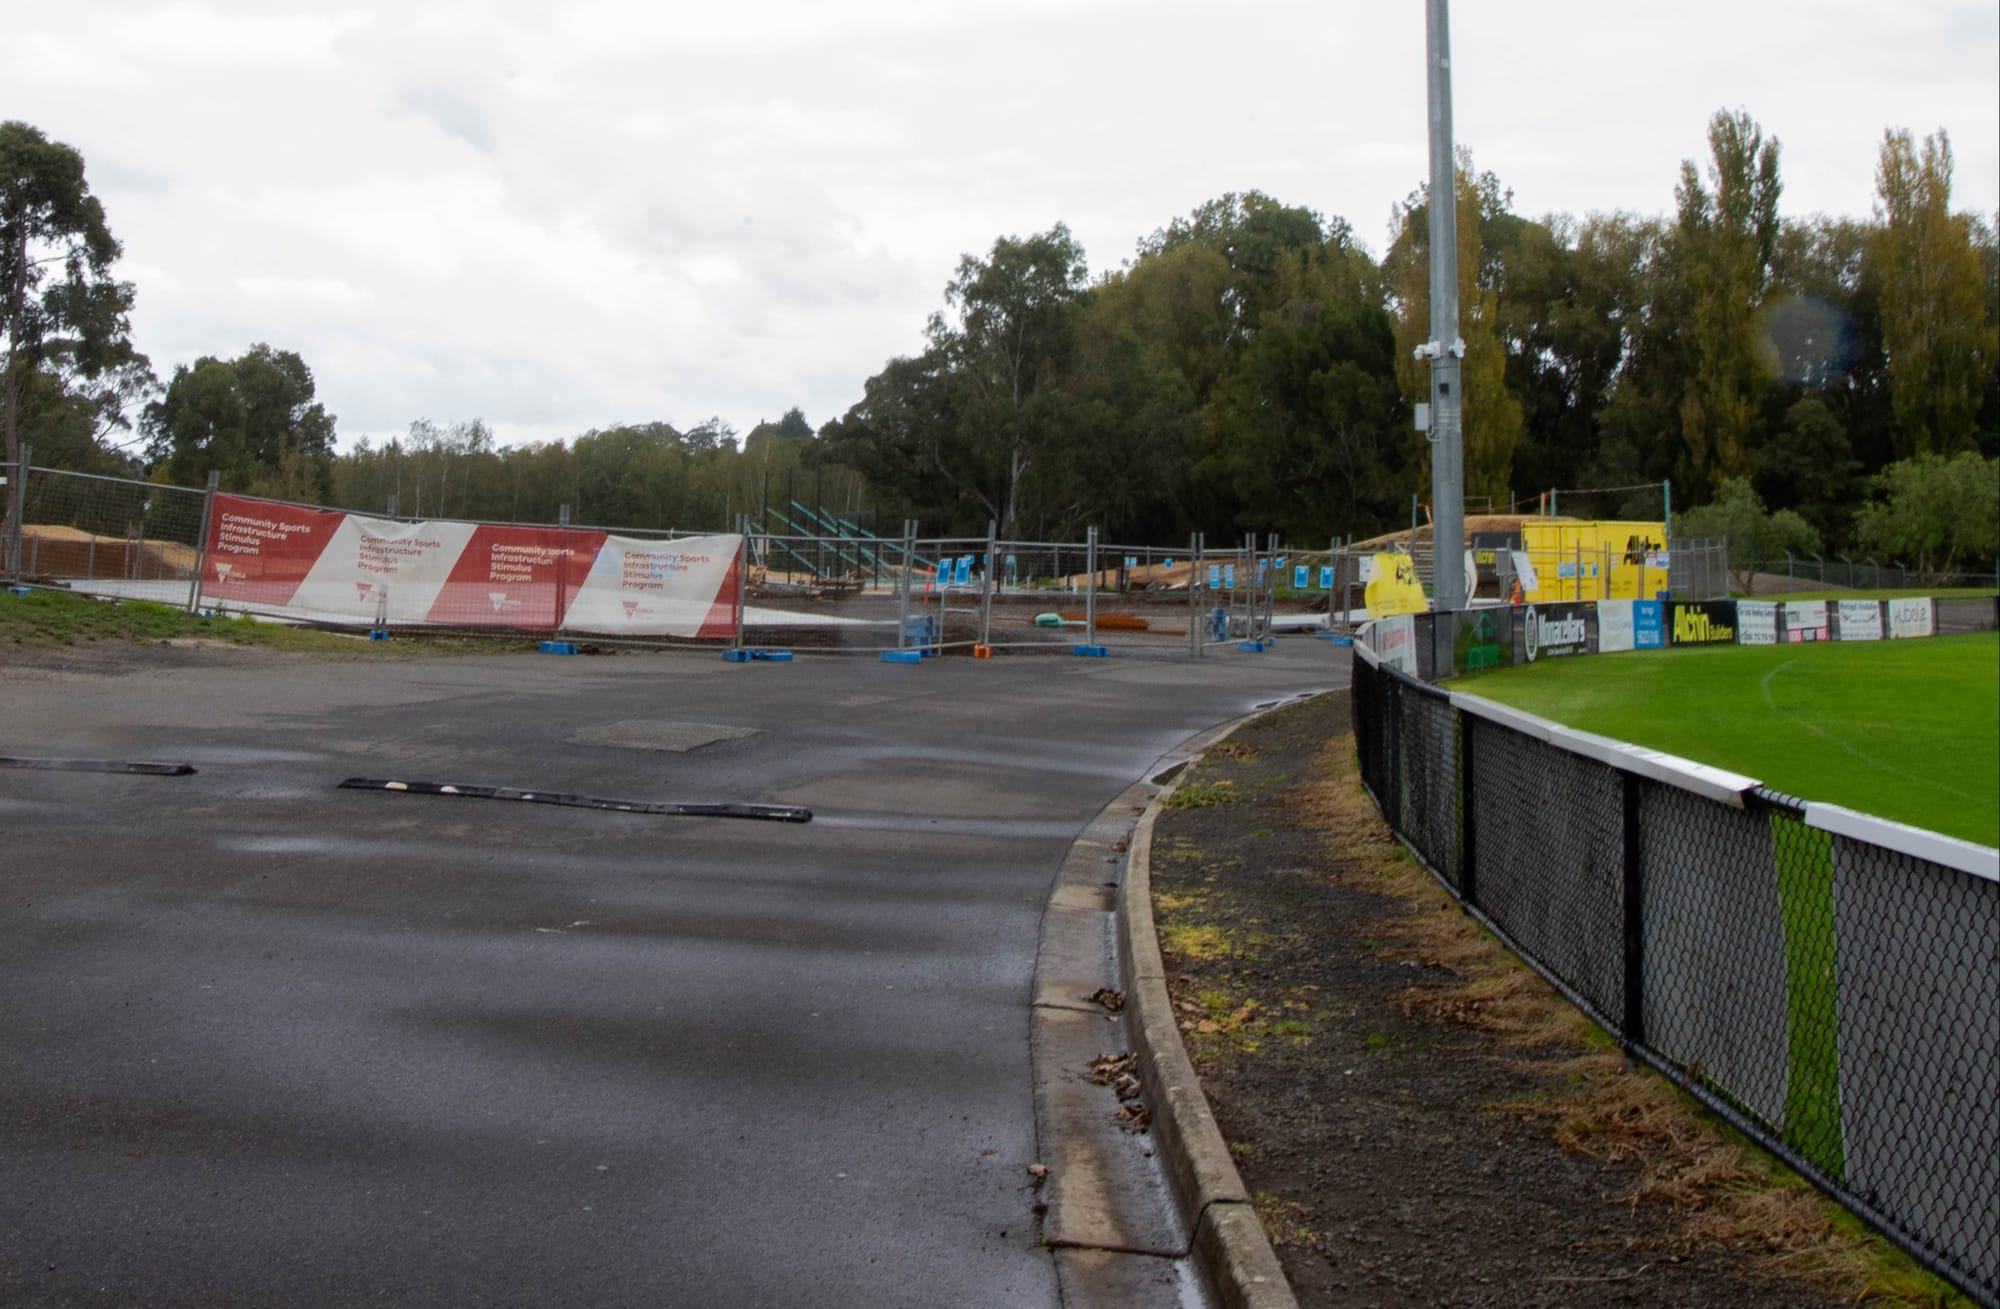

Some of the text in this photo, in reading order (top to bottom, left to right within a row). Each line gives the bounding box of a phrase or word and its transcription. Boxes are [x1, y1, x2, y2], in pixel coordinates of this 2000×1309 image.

[222, 512, 311, 533] Community Sports
[220, 522, 287, 540] Infrastructure
[219, 532, 260, 545] Stimulus
[414, 538, 441, 548] Sports
[217, 541, 259, 555] Program
[360, 544, 422, 556] Infrastructure
[491, 543, 547, 557] Community
[359, 552, 398, 564] Stimulus
[624, 551, 710, 563] Community Sports
[357, 560, 398, 574] Program
[490, 561, 532, 573] Stimulus
[623, 561, 688, 571] Infrastructure
[489, 571, 532, 583] Program
[623, 570, 663, 580] Stimulus
[622, 579, 664, 590] Program
[1673, 604, 1710, 643] Allchin
